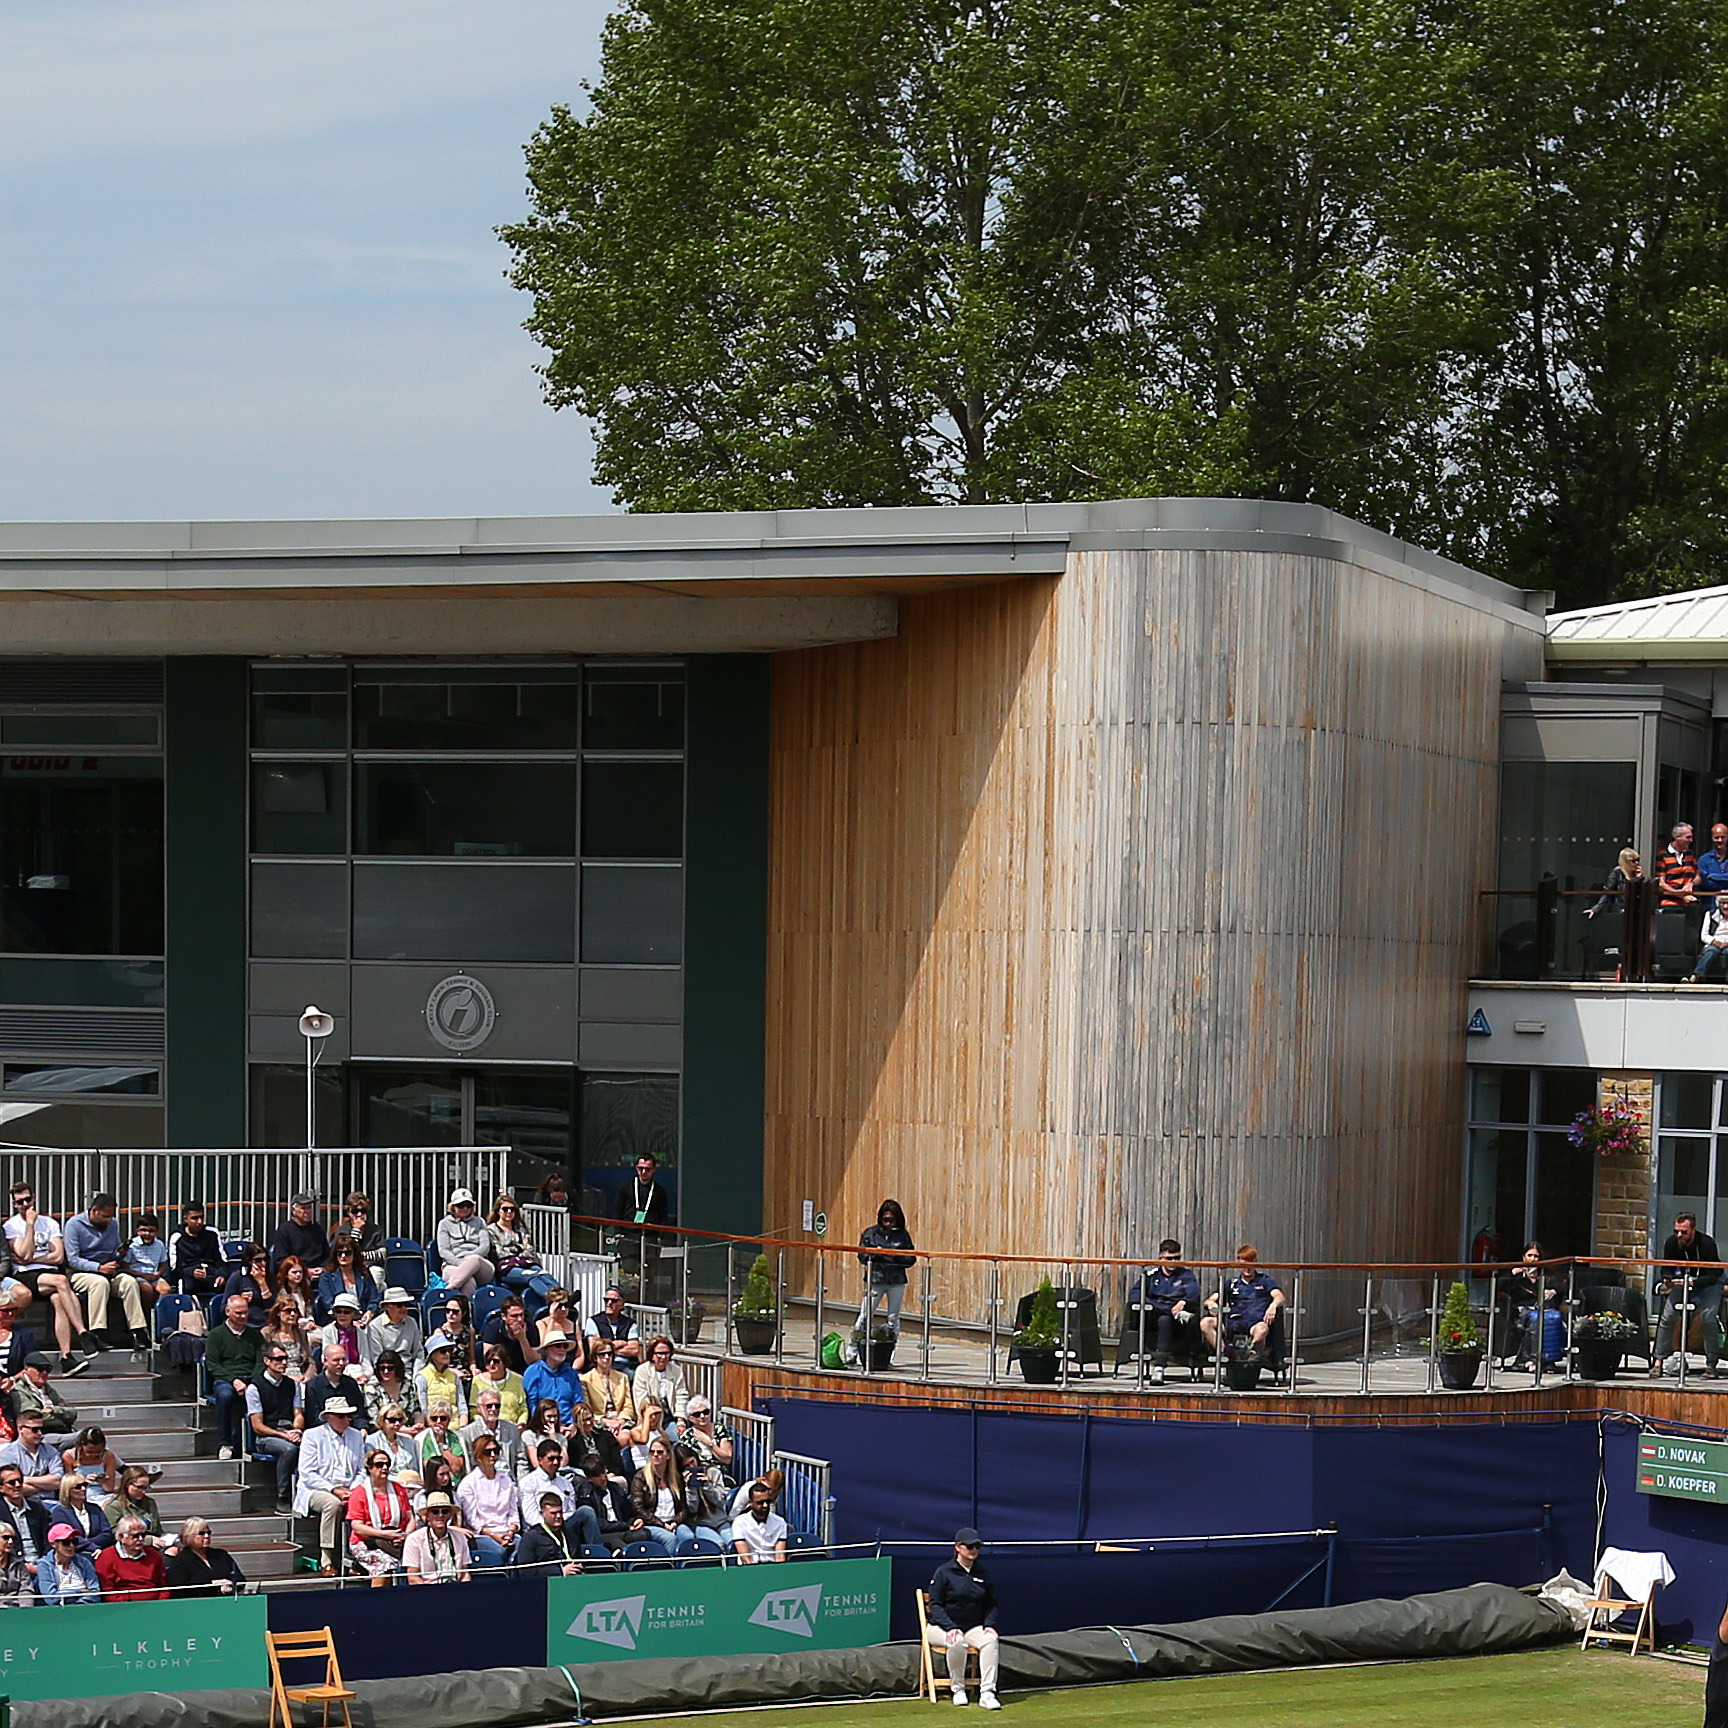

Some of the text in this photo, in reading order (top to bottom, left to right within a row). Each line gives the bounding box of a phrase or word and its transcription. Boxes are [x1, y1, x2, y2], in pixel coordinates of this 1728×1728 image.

[1658, 1446, 1668, 1460] D.
[1671, 1448, 1706, 1465] NOVAK
[1656, 1474, 1666, 1488] D.
[1669, 1475, 1716, 1494] KOEPFER
[765, 1592, 877, 1623] LTA TENNIS
[824, 1605, 877, 1617] FOR BRITAIN
[586, 1603, 705, 1633] LTA TENNIS
[648, 1617, 705, 1629] FOR BRITAIN
[92, 1636, 223, 1656] ILKLEY
[125, 1657, 192, 1671] TROPHY
